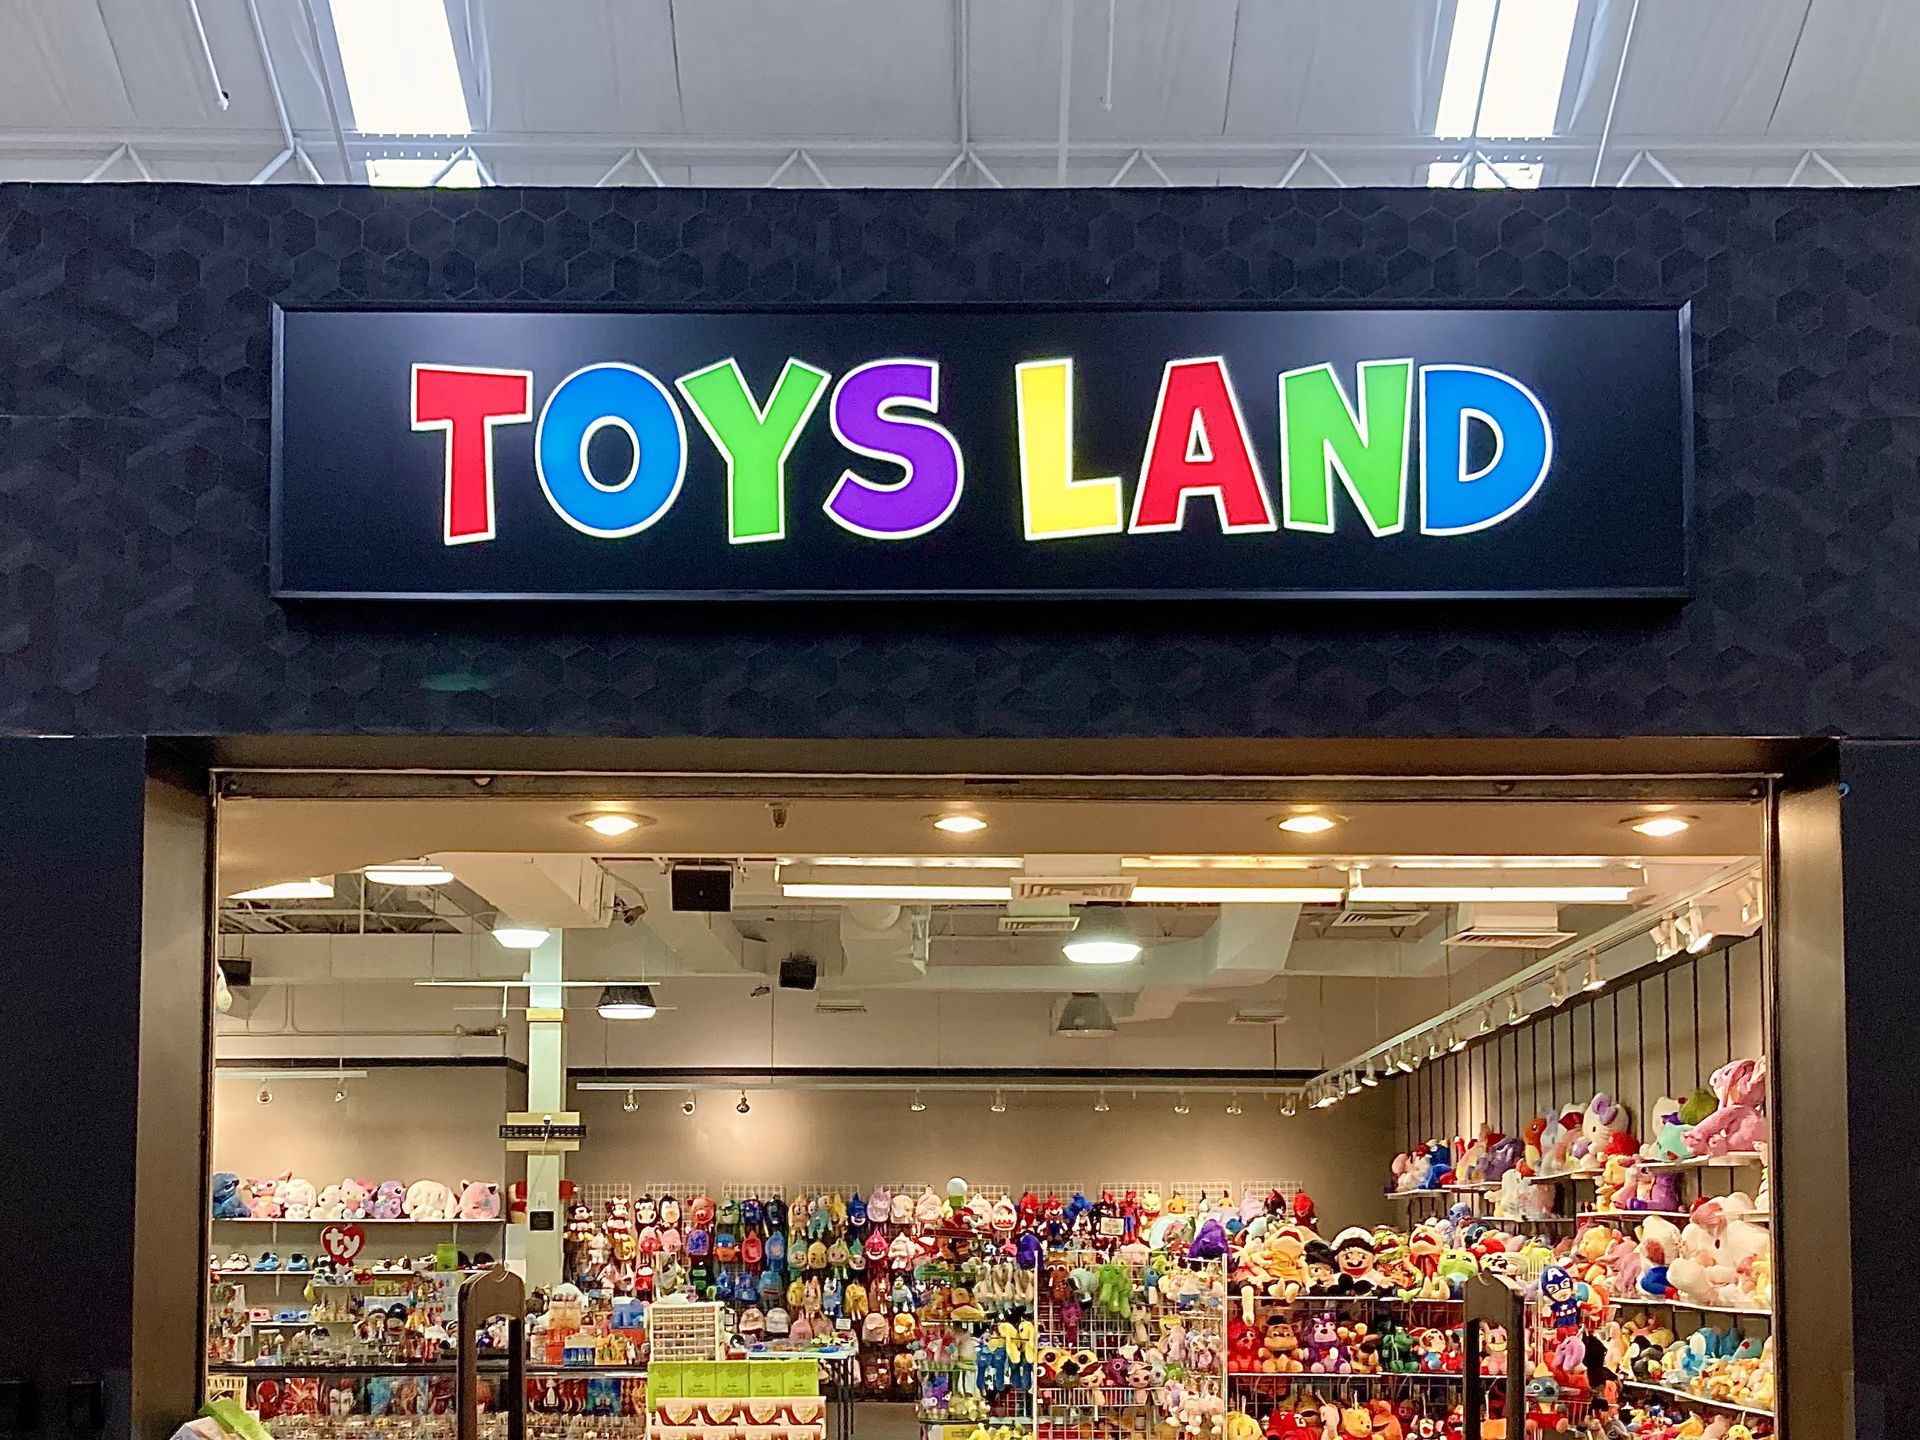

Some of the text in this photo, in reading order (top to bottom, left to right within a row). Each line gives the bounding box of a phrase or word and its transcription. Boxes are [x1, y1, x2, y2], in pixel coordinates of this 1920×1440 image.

[411, 356, 1554, 545] TOYS LAND
[325, 1228, 360, 1259] ty
